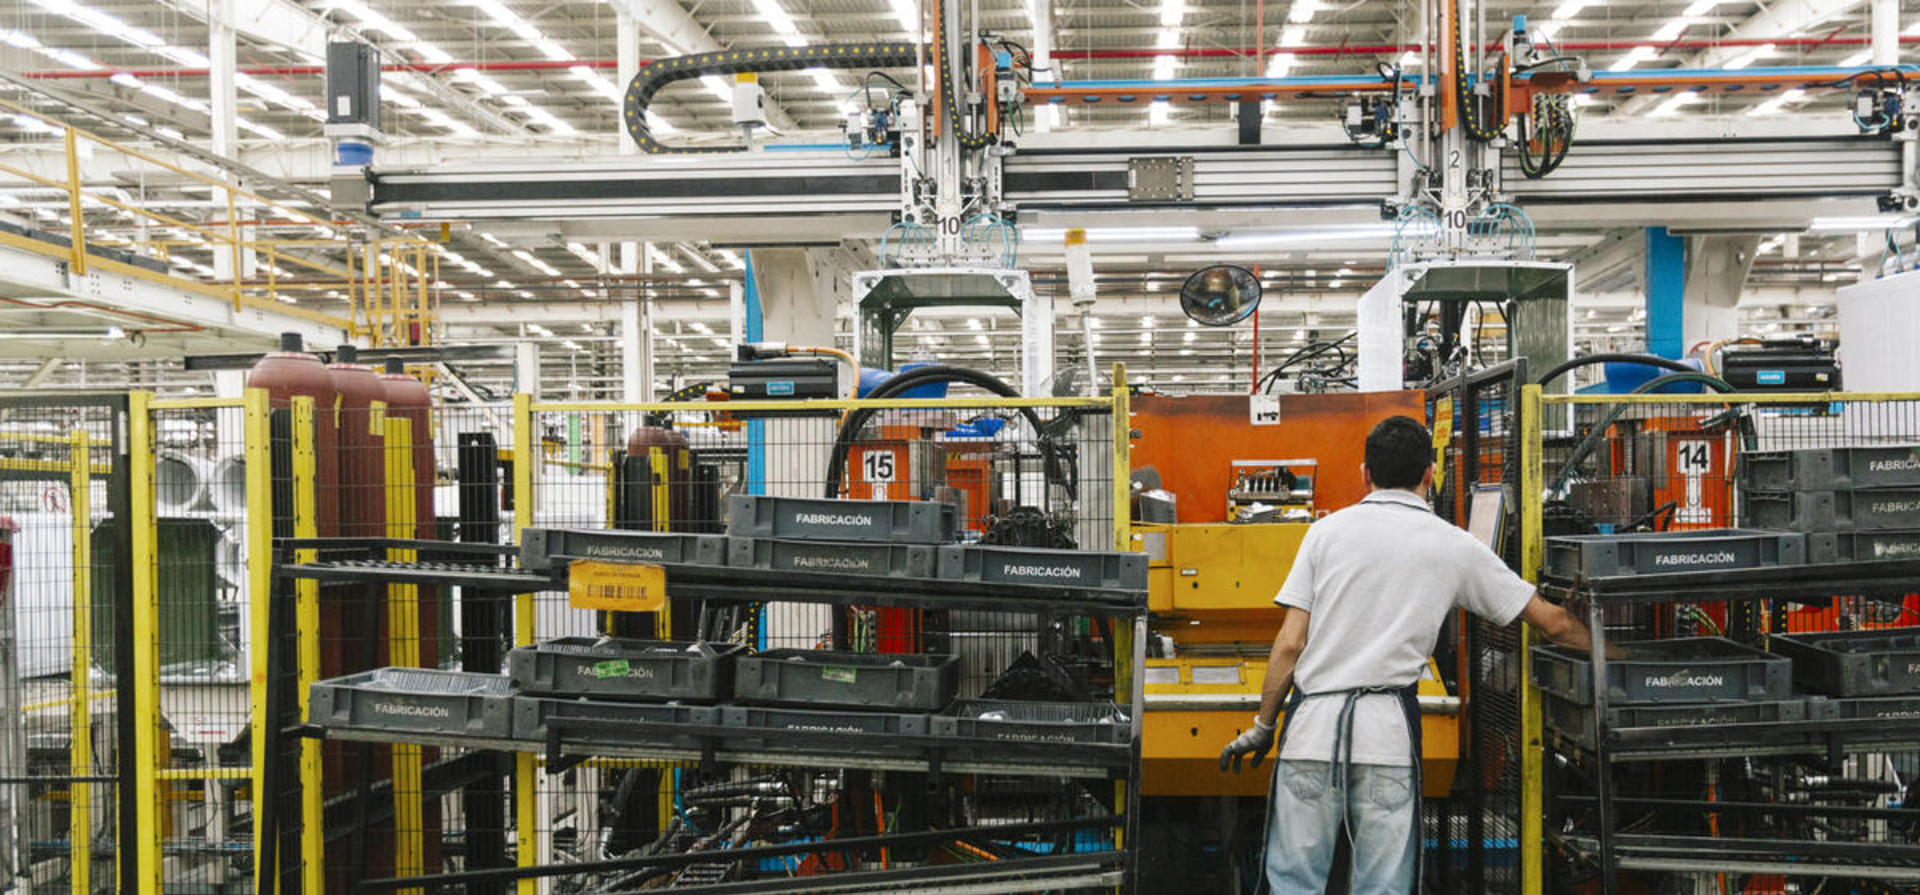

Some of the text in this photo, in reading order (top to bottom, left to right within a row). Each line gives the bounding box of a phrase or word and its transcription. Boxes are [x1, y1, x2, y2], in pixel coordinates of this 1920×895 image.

[1450, 150, 1460, 168] 2
[937, 216, 960, 235] 10
[1444, 209, 1466, 229] 10
[1679, 444, 1708, 469] 14
[865, 455, 893, 479] 15
[796, 513, 872, 526] FABRICACIÓN
[587, 545, 663, 558] FABRICACIÓN
[1655, 551, 1735, 566] FABRICACIÓN
[794, 555, 869, 569] FABRICACIÓN
[1004, 564, 1080, 578] FABRICACIÓN
[375, 702, 449, 717] FABRICACIÓN
